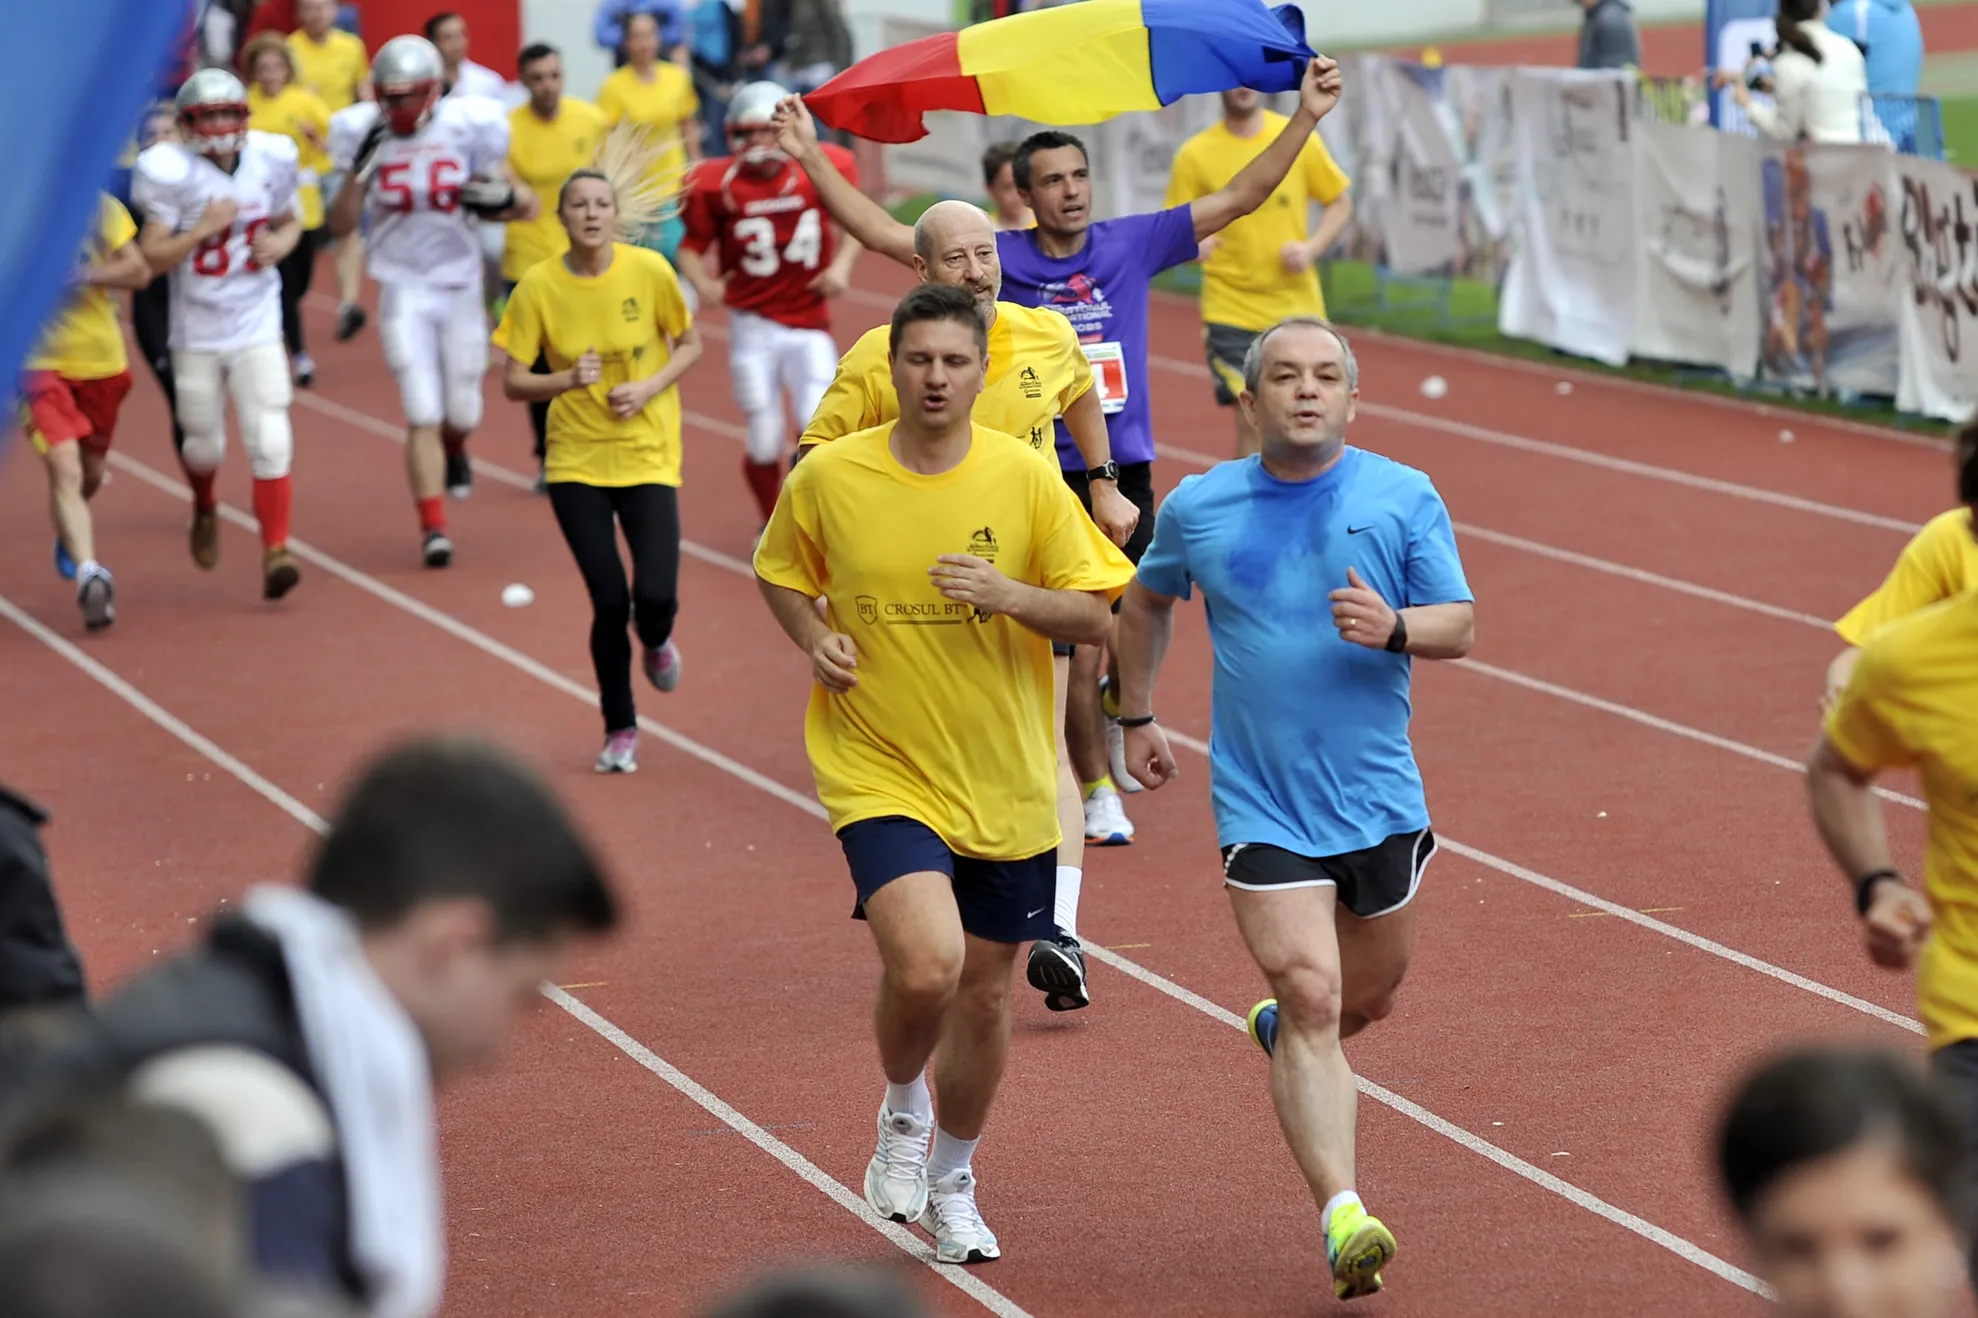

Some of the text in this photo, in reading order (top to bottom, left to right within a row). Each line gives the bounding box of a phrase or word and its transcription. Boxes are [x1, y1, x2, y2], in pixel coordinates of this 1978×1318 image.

[380, 159, 461, 215] 56
[734, 207, 822, 277] 34
[884, 603, 961, 616] CROSUL BT
